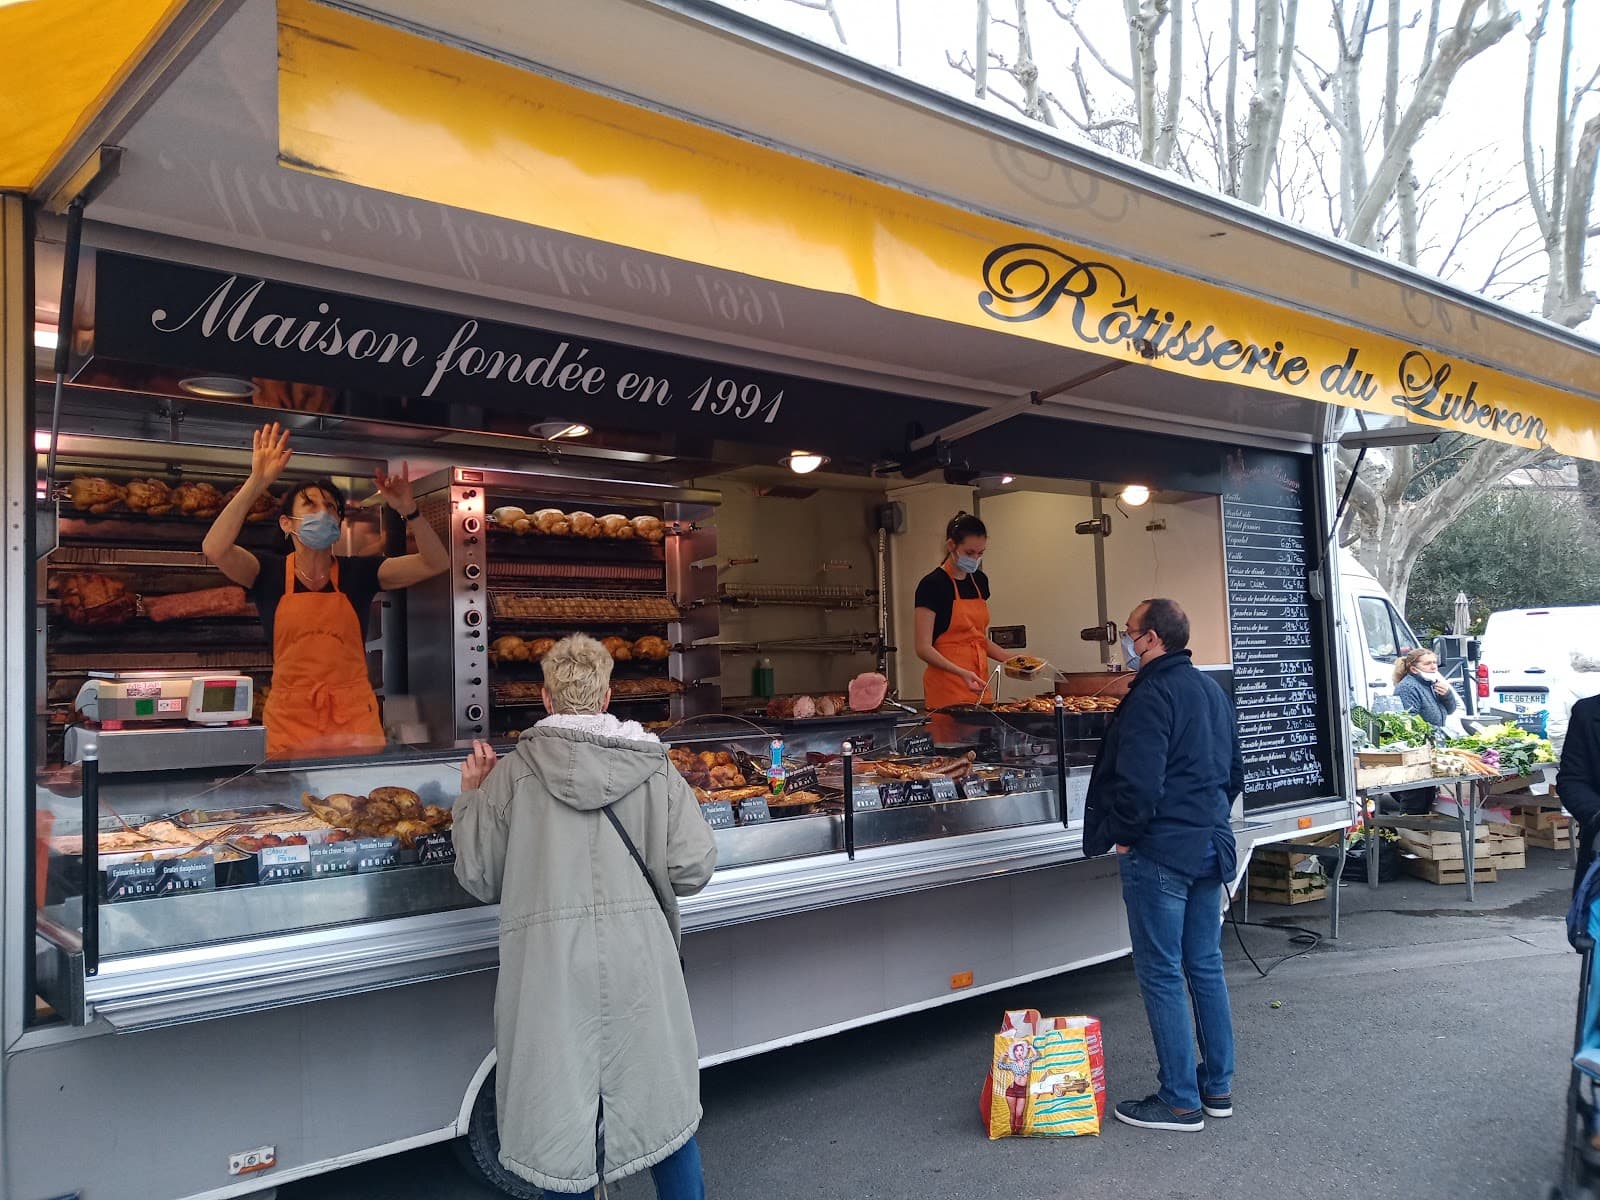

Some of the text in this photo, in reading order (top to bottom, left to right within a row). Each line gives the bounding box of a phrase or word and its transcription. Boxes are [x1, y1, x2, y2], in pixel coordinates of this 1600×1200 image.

[152, 275, 784, 424] Maison fondée en 1991
[978, 243, 1548, 442] Rôtisserie du Luberon
